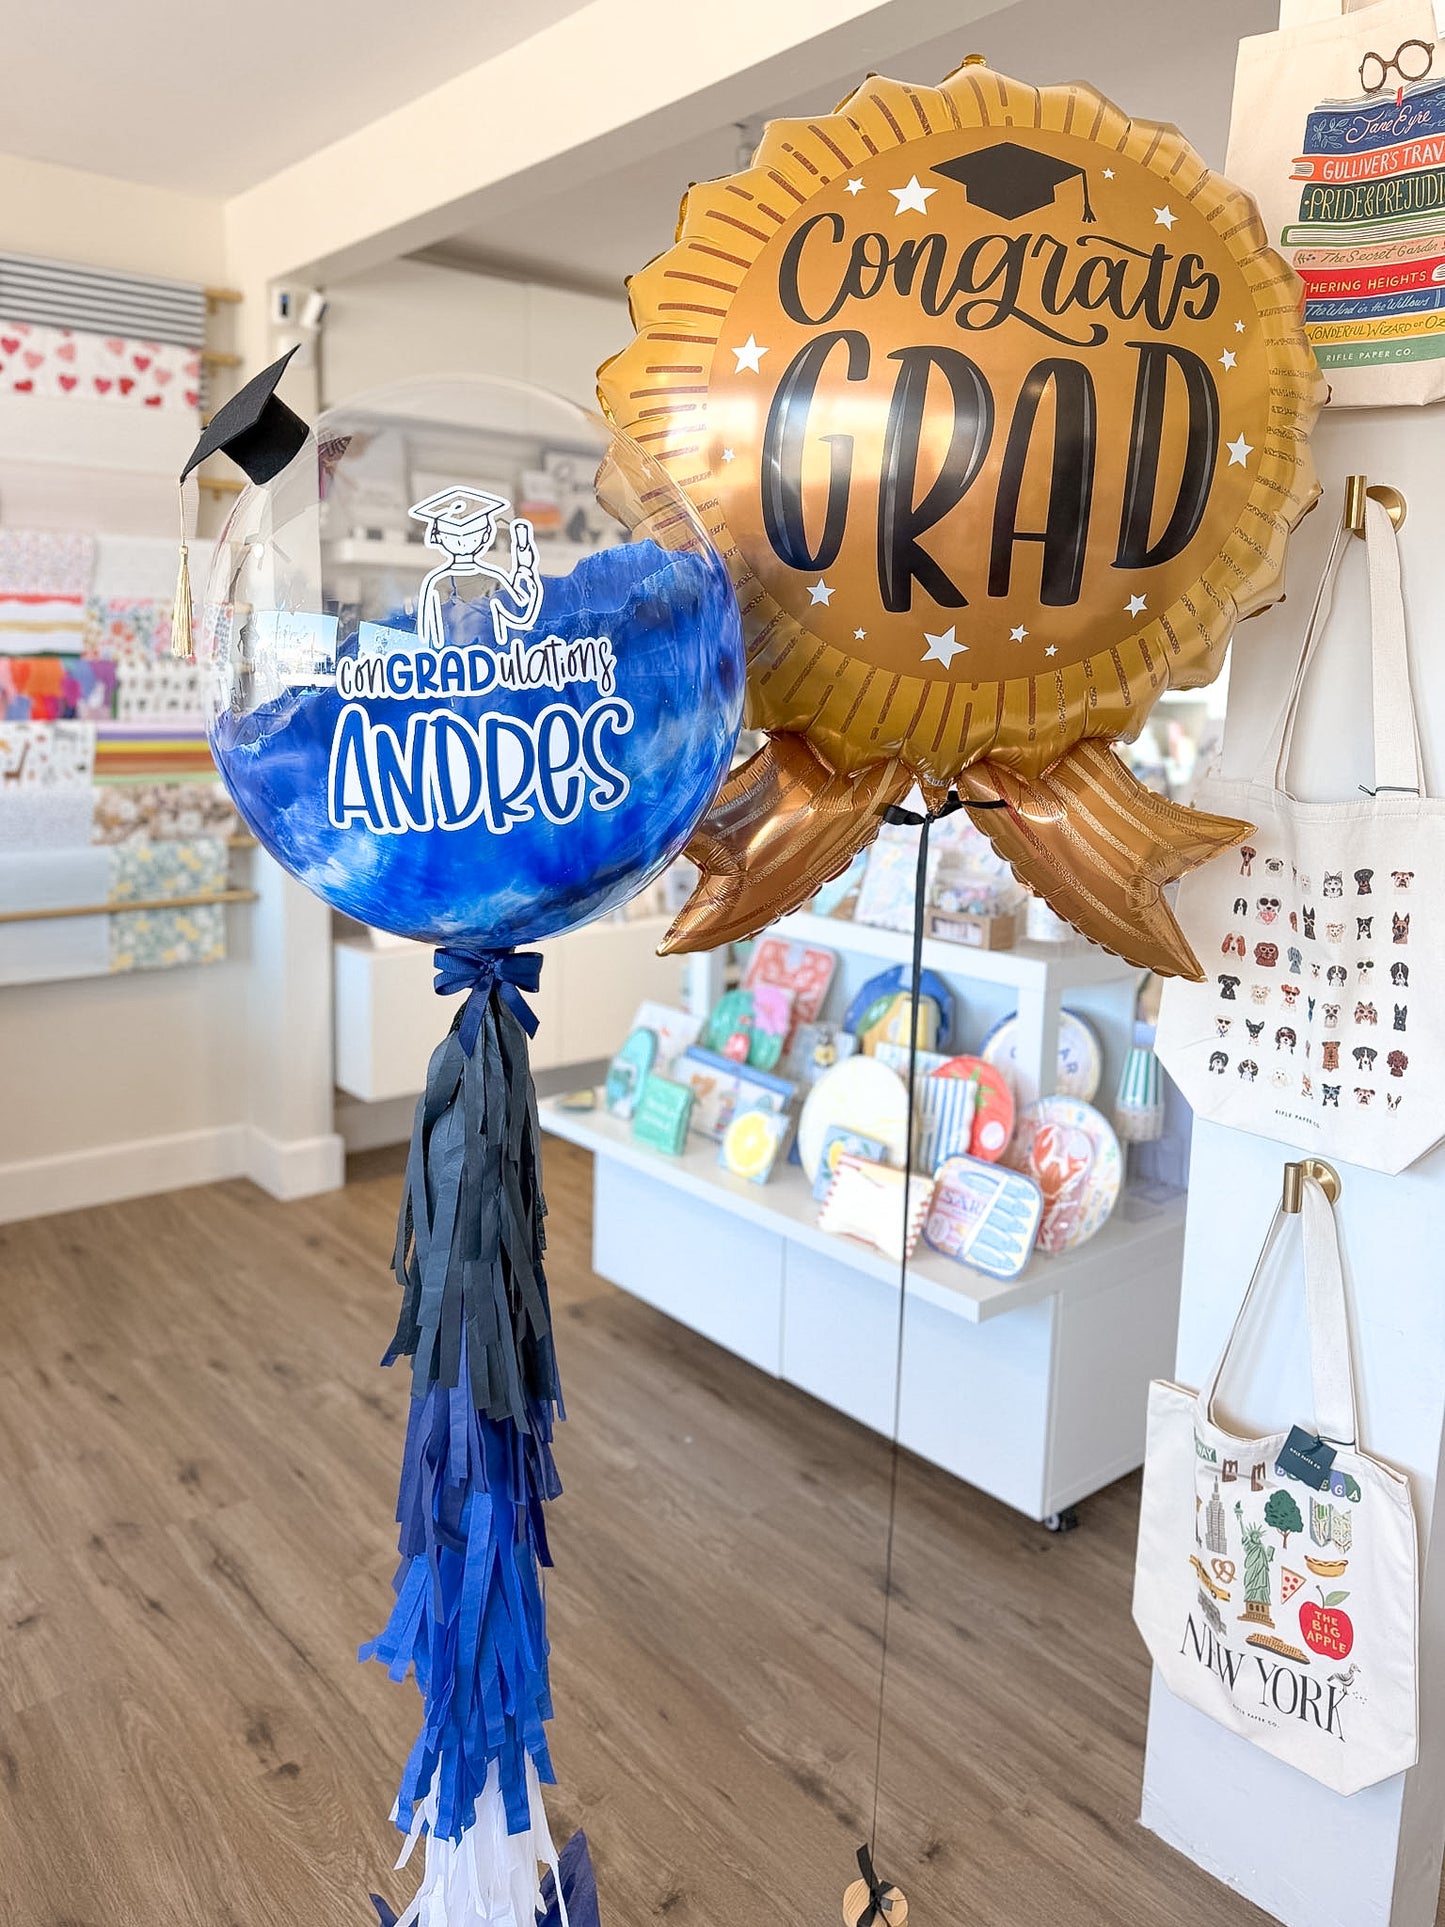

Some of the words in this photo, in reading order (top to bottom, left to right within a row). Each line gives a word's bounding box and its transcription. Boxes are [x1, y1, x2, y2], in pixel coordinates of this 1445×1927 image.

[1346, 110, 1394, 143] Jane
[1393, 105, 1432, 136] Eyre
[1322, 151, 1399, 180] GULLIVER'S
[1320, 252, 1346, 263] The
[1346, 245, 1397, 263] Secret
[1397, 239, 1438, 257] Garden
[778, 212, 1221, 347] Congrats
[1367, 270, 1428, 290] HEIGHTS
[1305, 303, 1326, 316] The
[1326, 301, 1360, 317] Wind
[1357, 303, 1368, 314] in
[1371, 300, 1386, 312] the
[1387, 294, 1431, 310] Willows
[1366, 321, 1411, 337] WIZARD
[1326, 353, 1353, 362] RIFLE
[1359, 350, 1390, 360] PAPER
[1395, 347, 1414, 357] CO.
[760, 330, 1220, 613] GRAD
[1311, 1619, 1341, 1639] BIG
[1314, 1610, 1338, 1626] THE
[1306, 1630, 1347, 1654] APPLE
[1178, 1612, 1246, 1692] NEW
[1253, 1655, 1347, 1743] YORK
